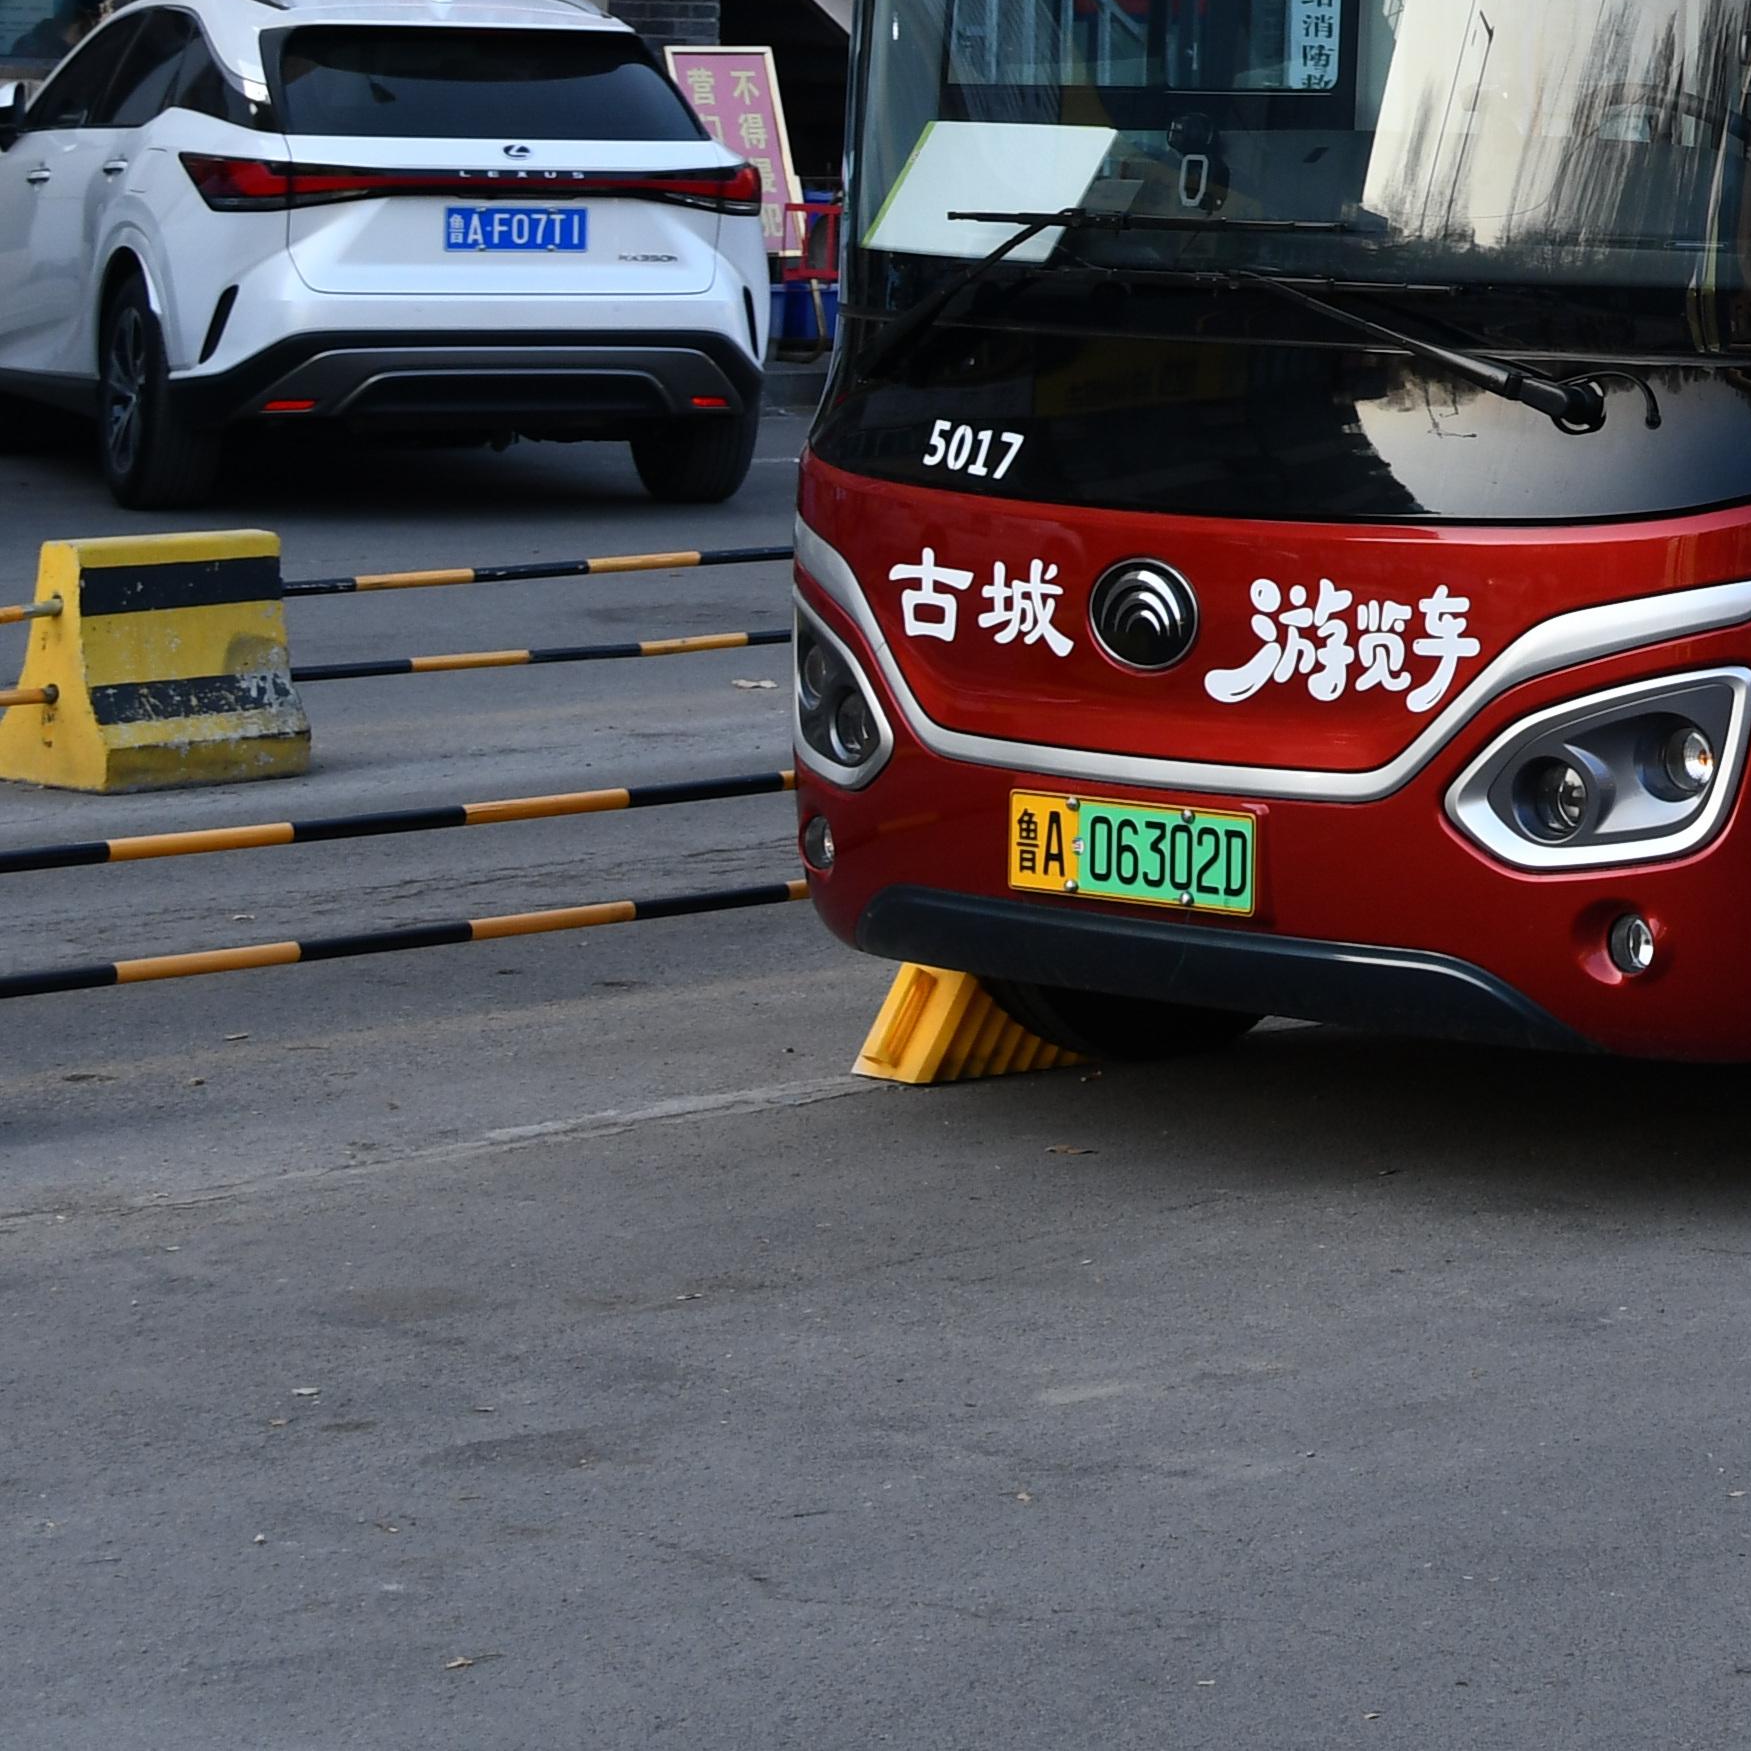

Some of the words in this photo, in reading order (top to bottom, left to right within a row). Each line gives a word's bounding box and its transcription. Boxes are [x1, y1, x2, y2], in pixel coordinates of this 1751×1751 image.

[459, 170, 585, 179] LEXUS
[923, 419, 1024, 479] 5017
[889, 547, 1074, 657] 古城
[1204, 578, 1480, 713] 游览车
